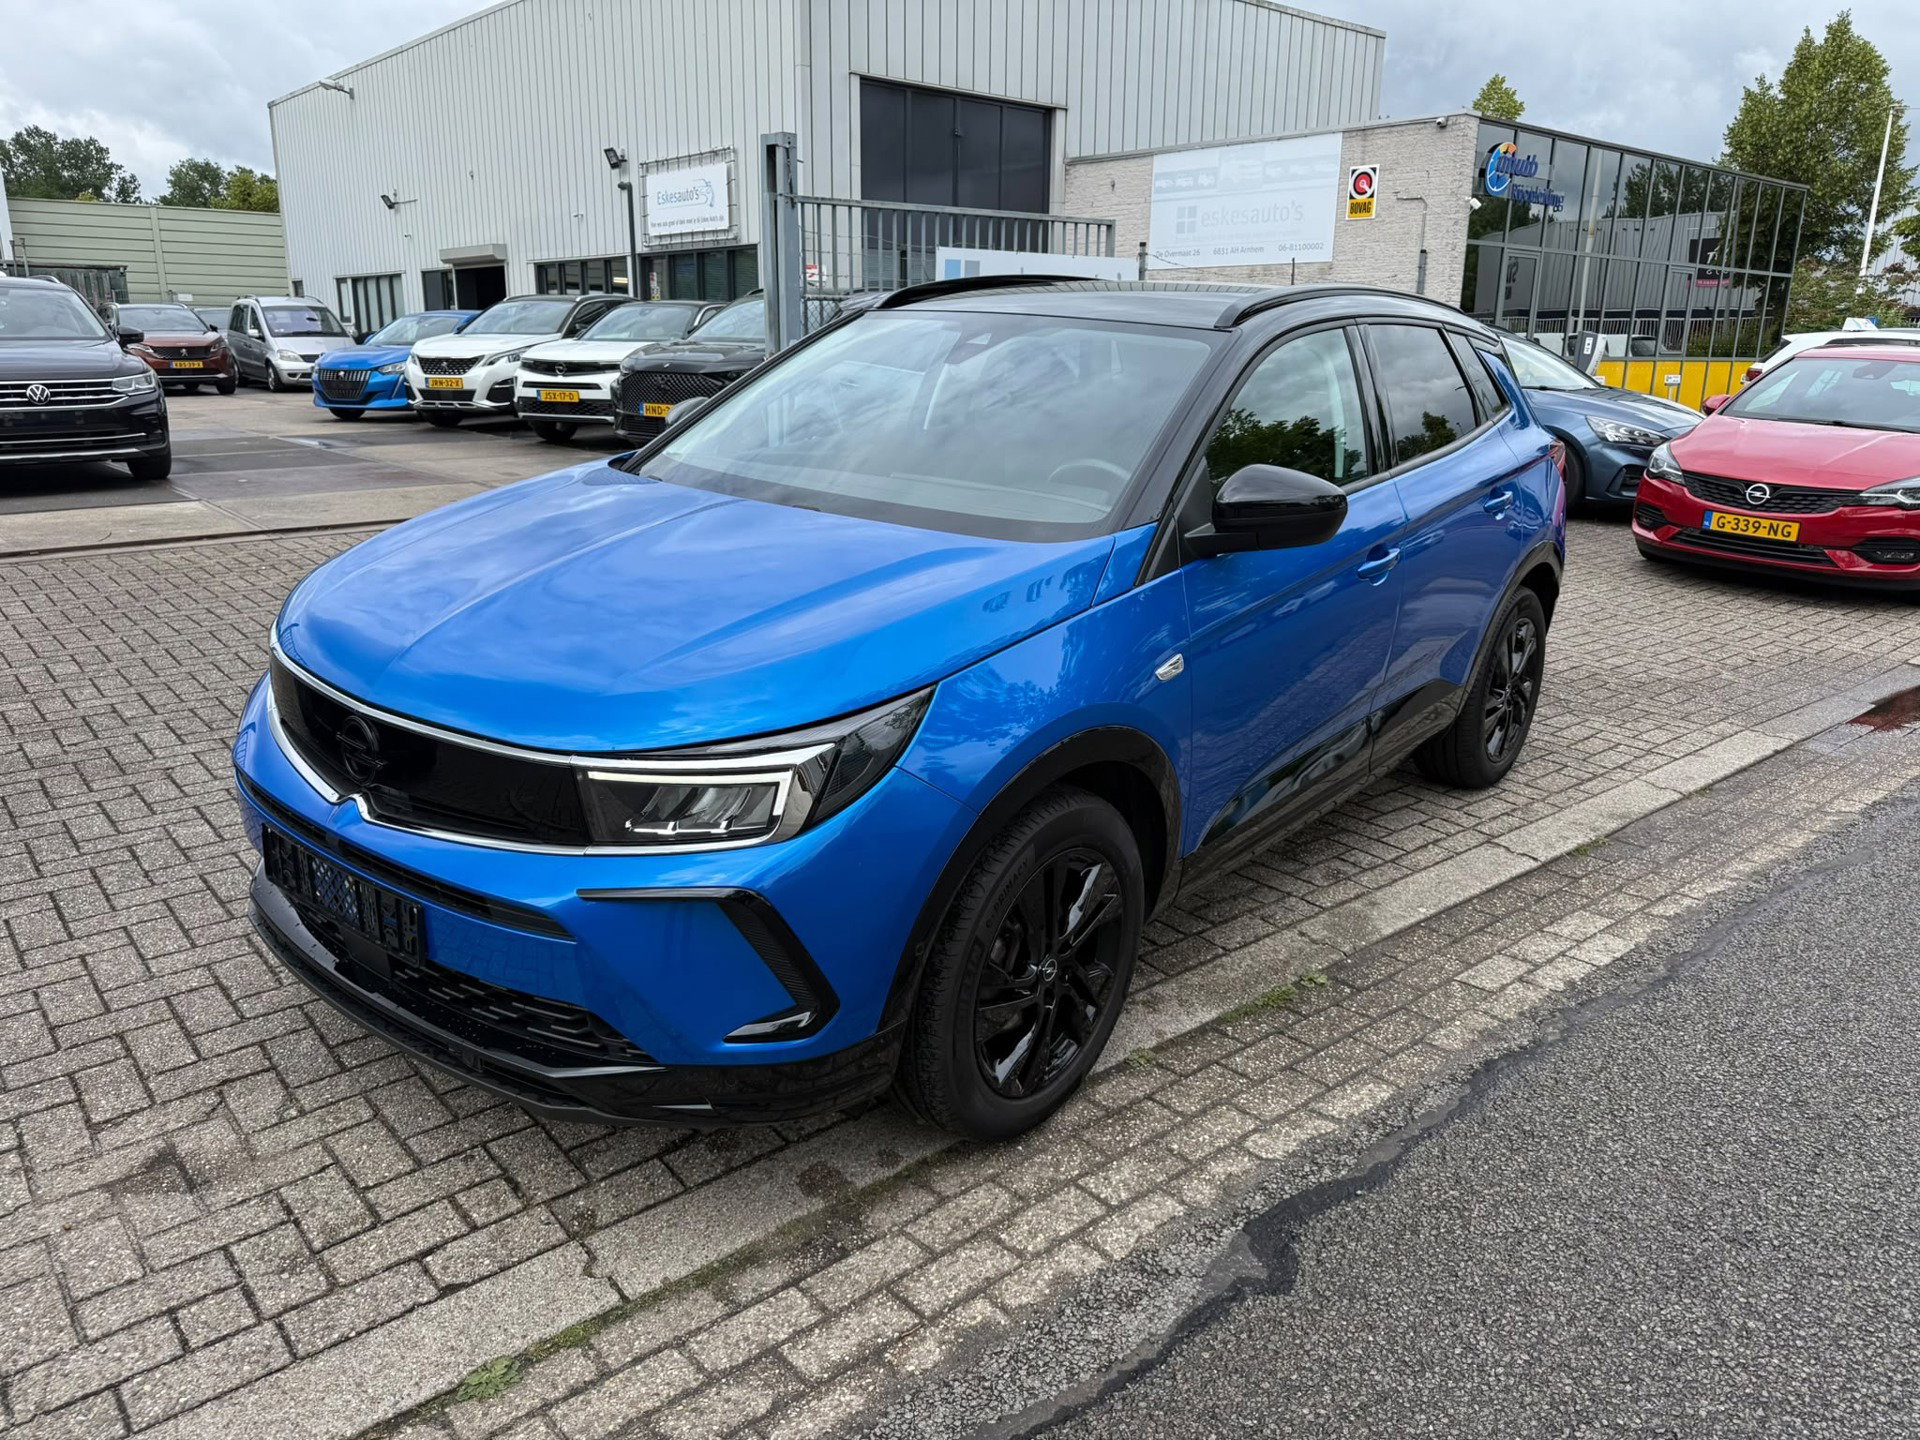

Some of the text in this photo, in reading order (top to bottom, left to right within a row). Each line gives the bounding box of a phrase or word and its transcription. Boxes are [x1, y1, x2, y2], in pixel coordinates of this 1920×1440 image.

[656, 186, 700, 205] Eskesauto's
[1200, 200, 1304, 228] eskesauto's
[1349, 201, 1372, 214] BOVAG
[1229, 246, 1240, 254] AH
[1240, 245, 1264, 254] Arnhem
[544, 391, 575, 401] JSX-17-D
[1716, 515, 1793, 538] G-339-NG
